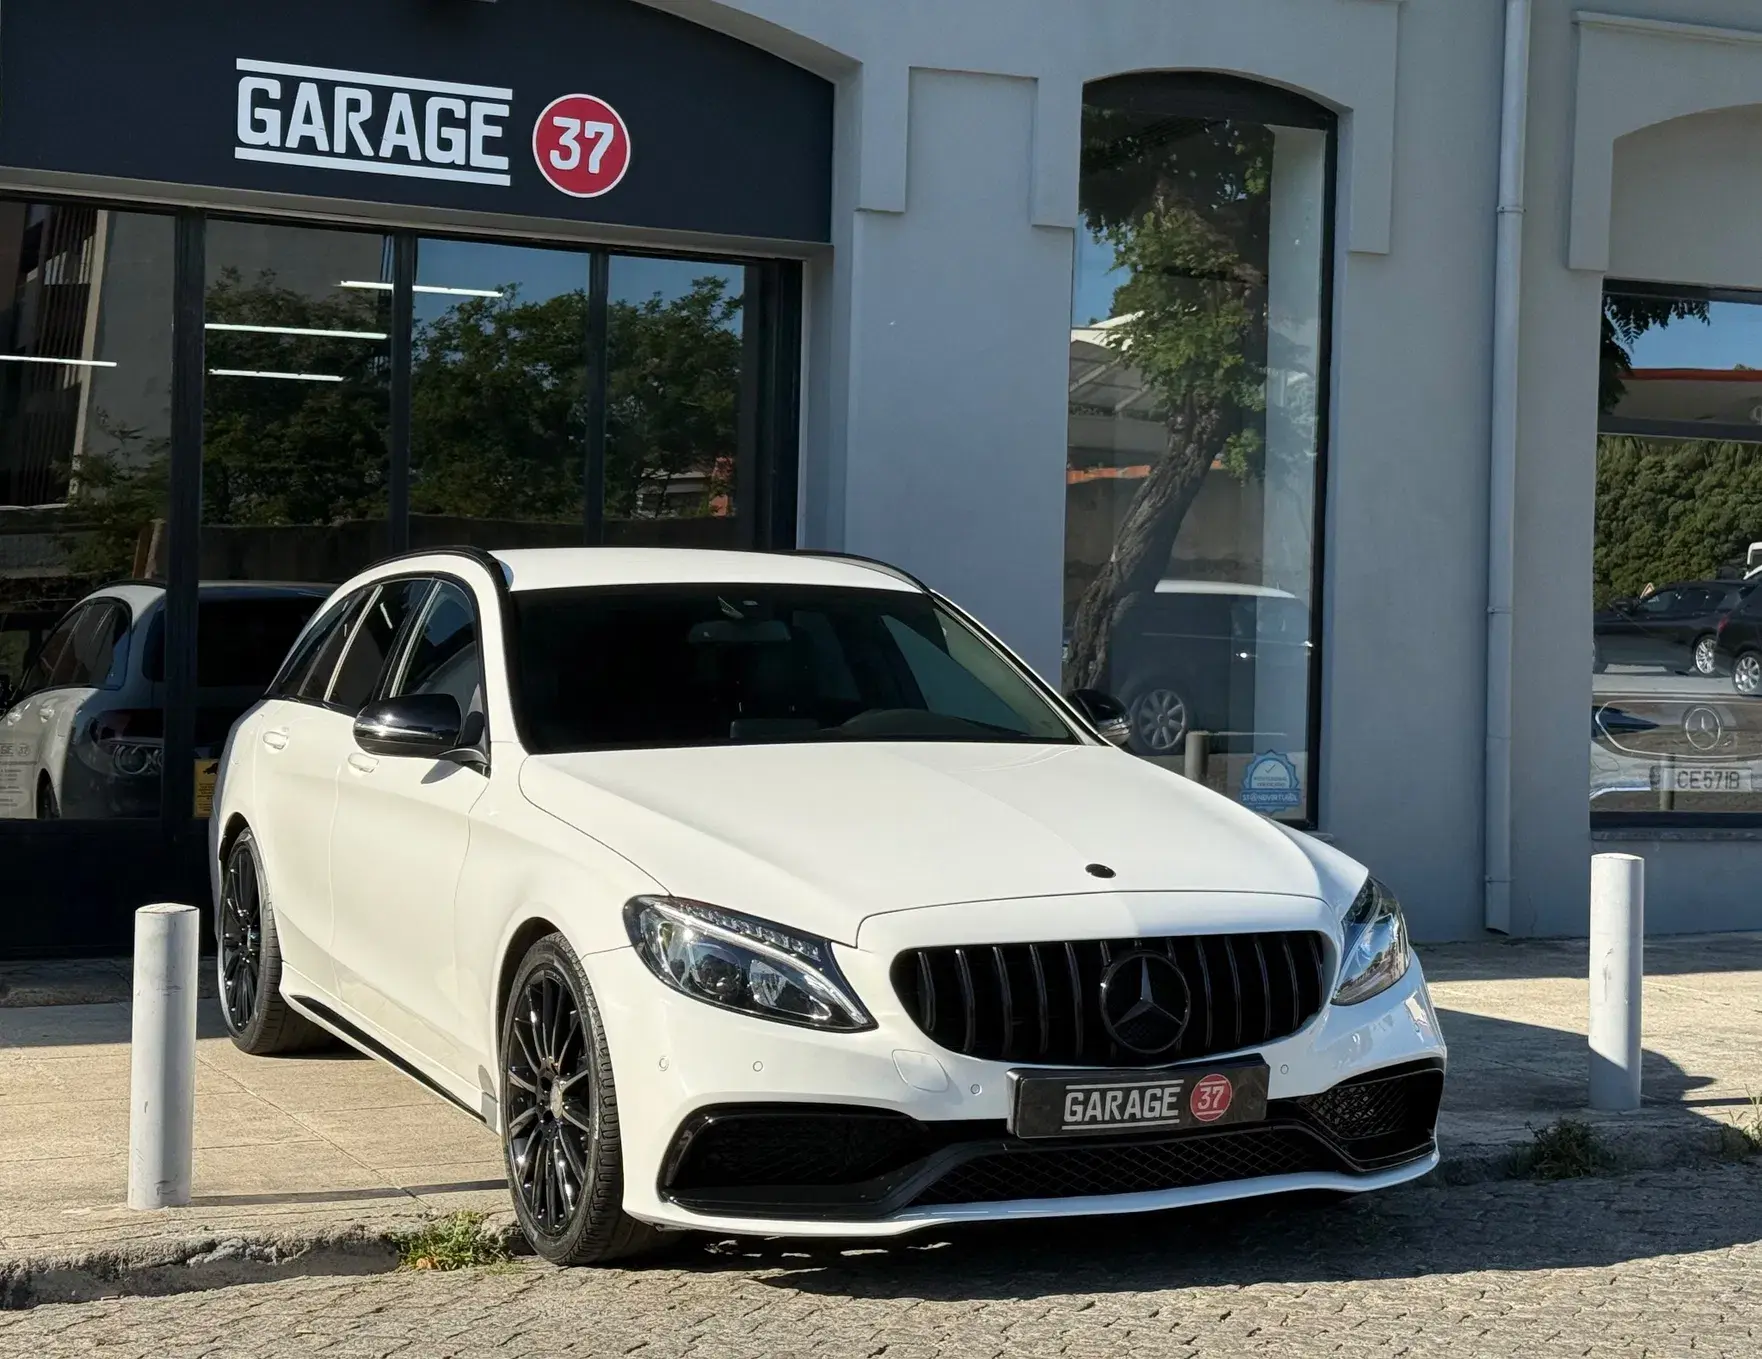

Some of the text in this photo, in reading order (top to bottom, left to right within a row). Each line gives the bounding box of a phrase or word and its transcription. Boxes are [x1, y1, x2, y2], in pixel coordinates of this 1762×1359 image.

[236, 75, 615, 175] GARAGE 37
[1064, 1085, 1225, 1122] GARAGE 37
